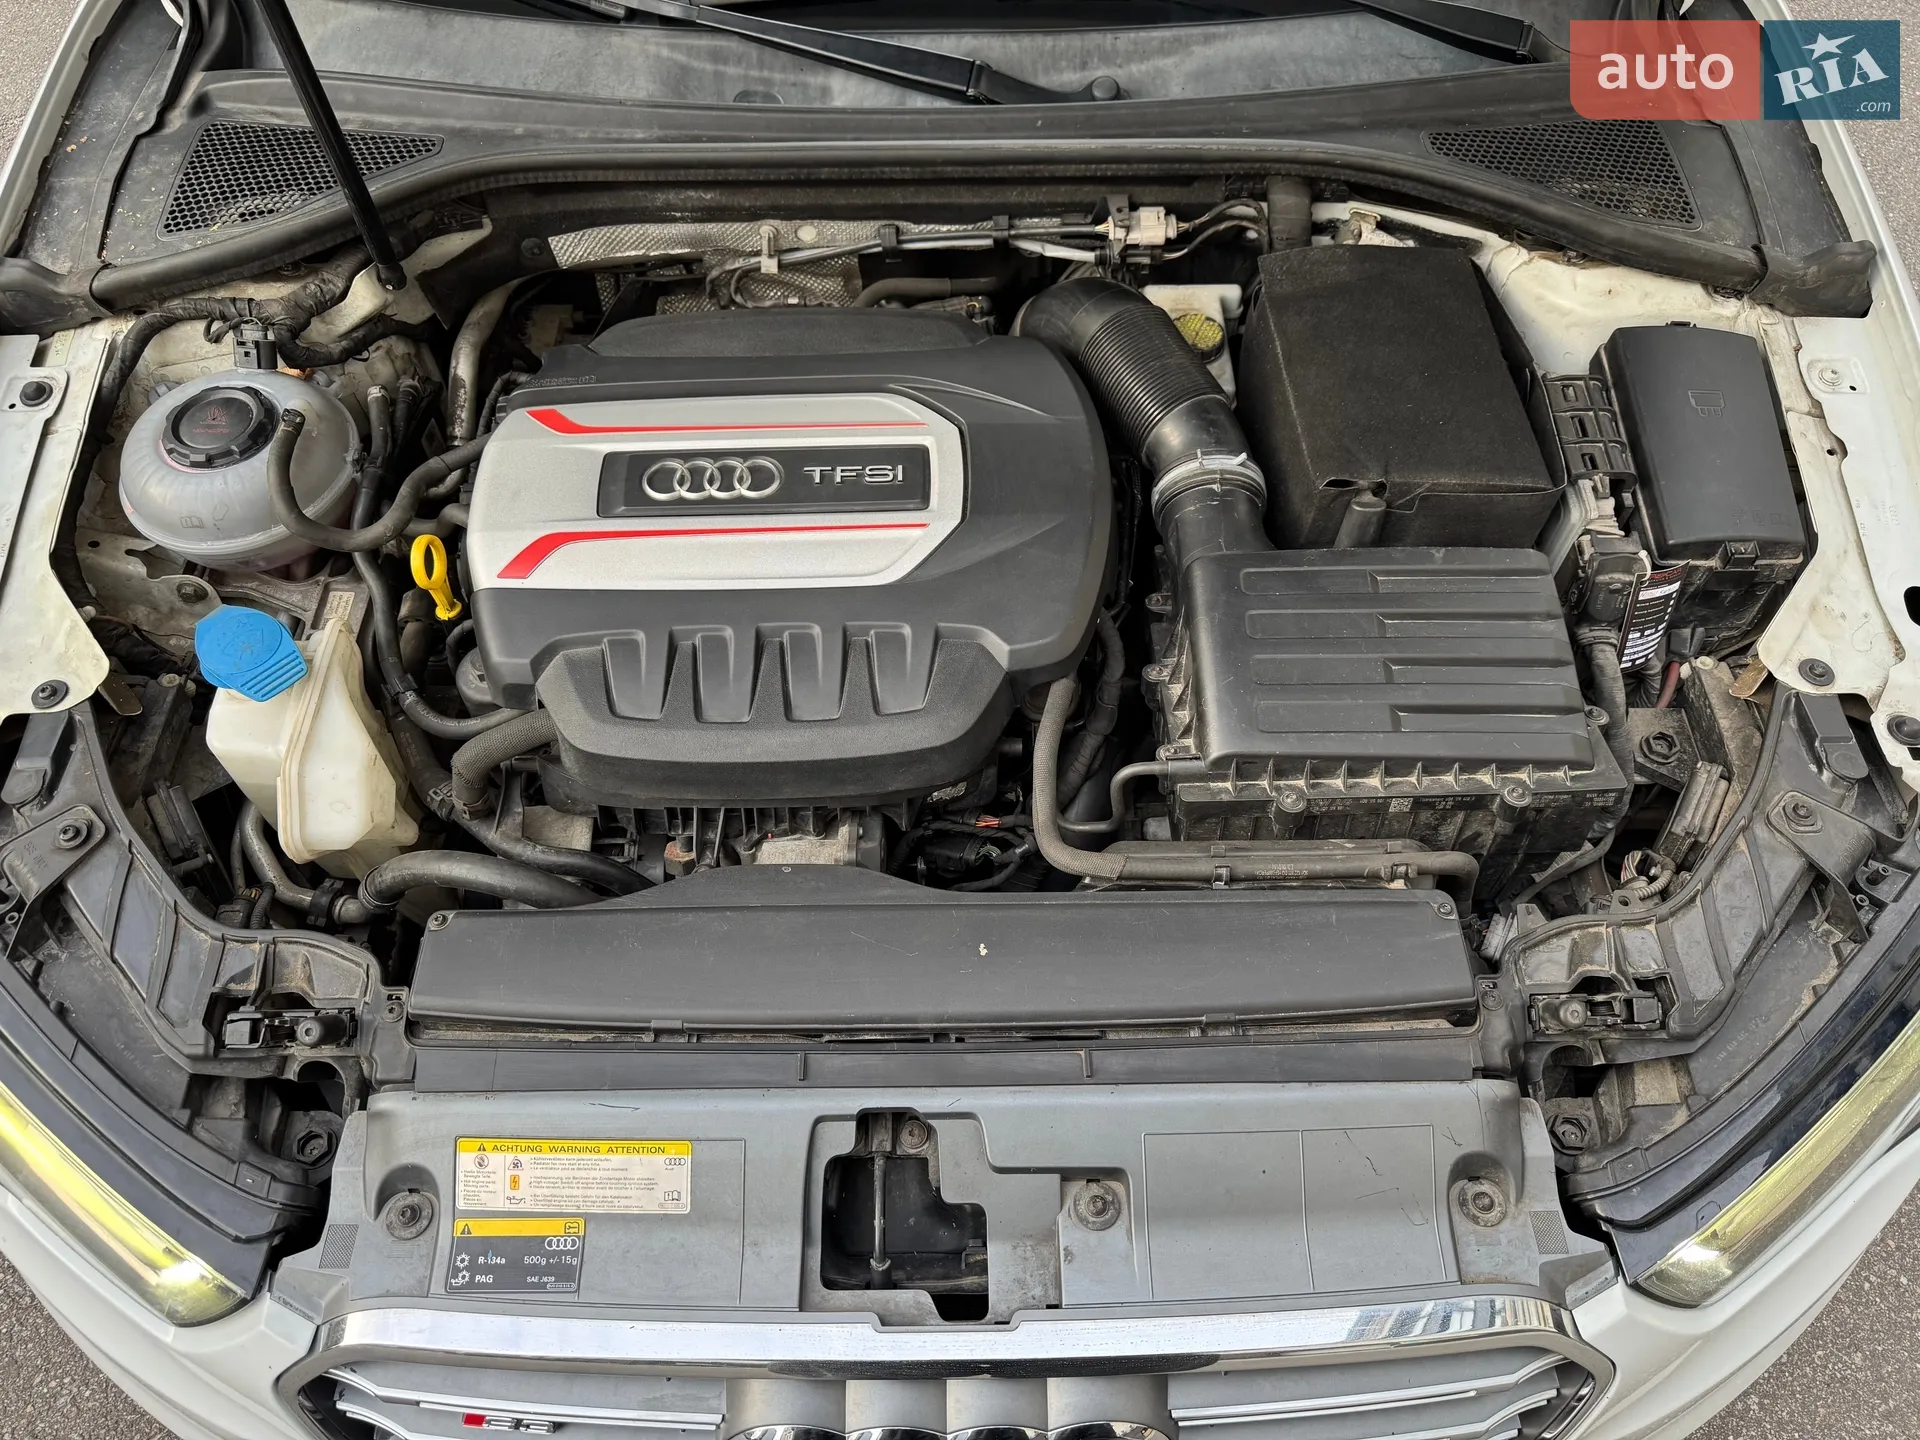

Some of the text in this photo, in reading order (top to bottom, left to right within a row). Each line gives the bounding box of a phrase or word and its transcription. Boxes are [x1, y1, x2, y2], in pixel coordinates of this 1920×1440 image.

[803, 464, 904, 485] TFSI
[492, 1144, 666, 1154] ACHTUNG WARNING ATTENTION
[478, 1256, 506, 1264] R-134a
[524, 1256, 547, 1265] 500g
[475, 1275, 494, 1283] PAG
